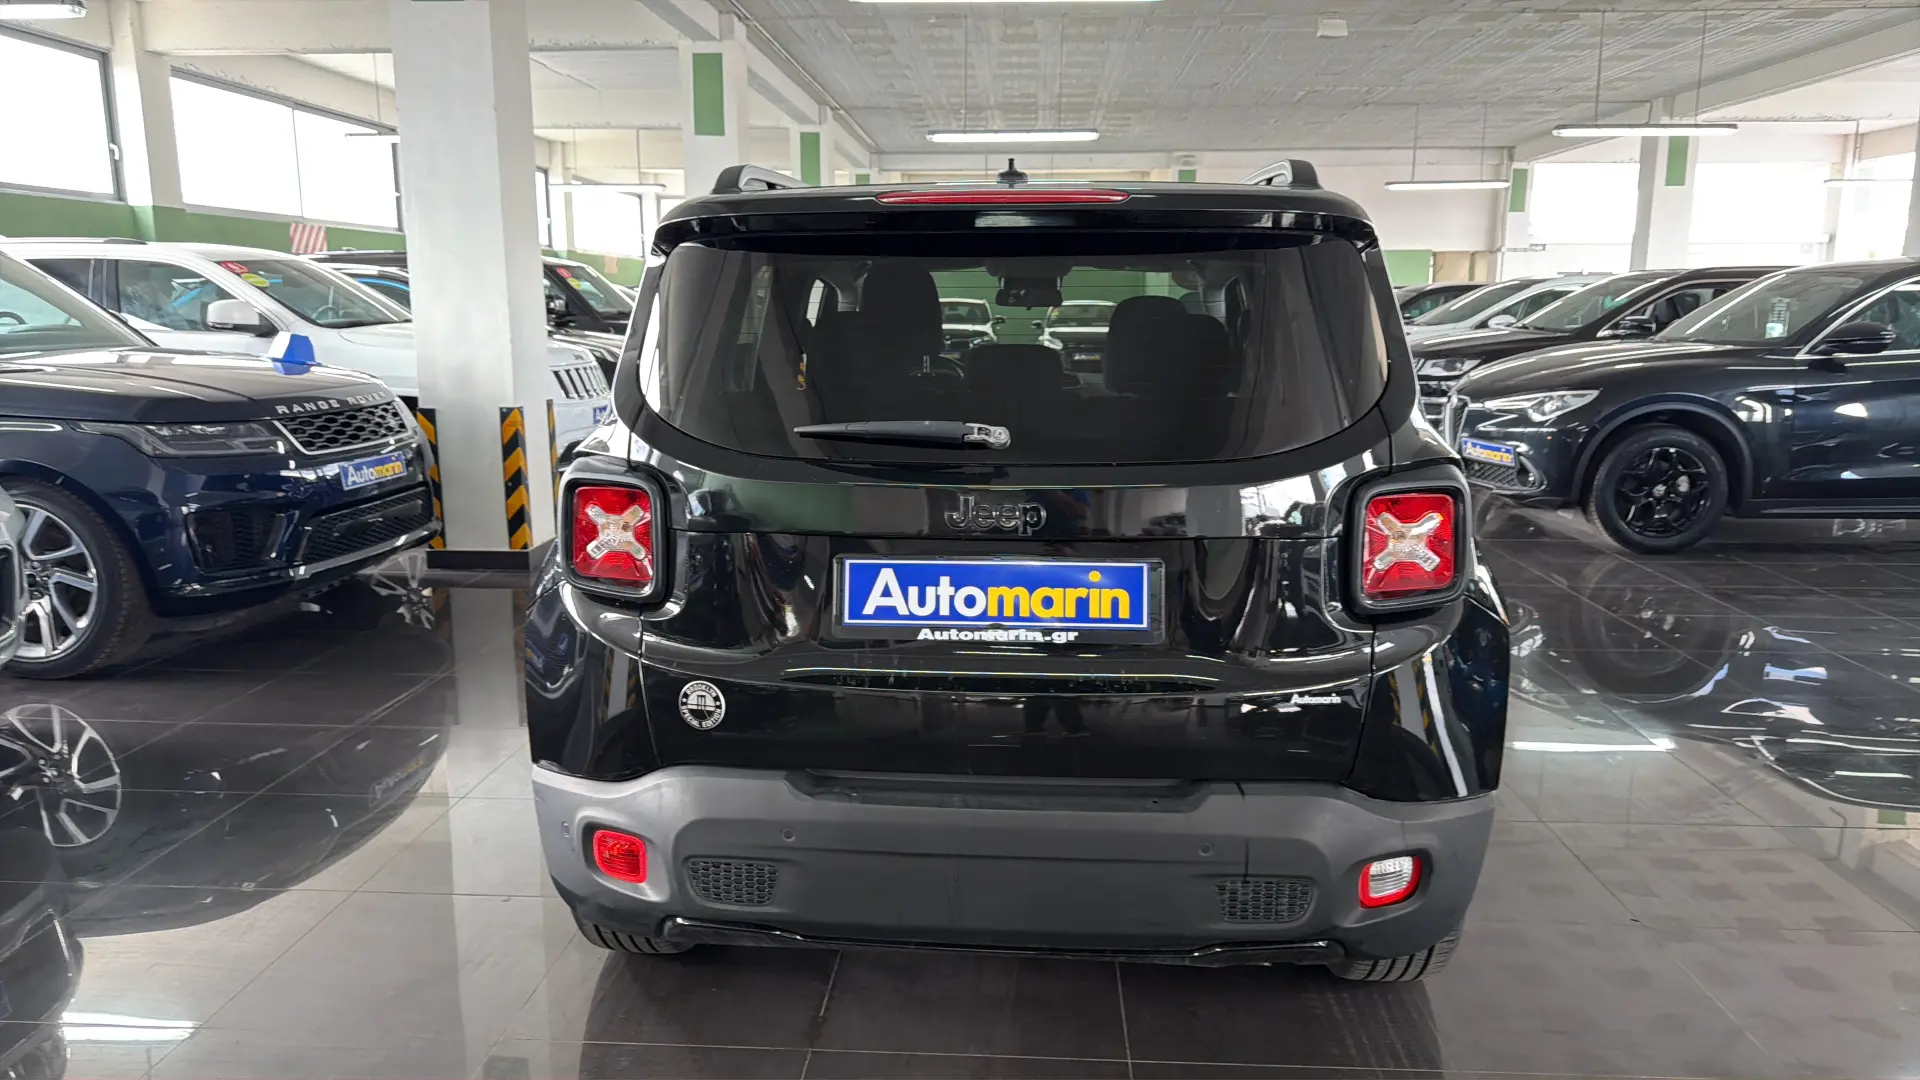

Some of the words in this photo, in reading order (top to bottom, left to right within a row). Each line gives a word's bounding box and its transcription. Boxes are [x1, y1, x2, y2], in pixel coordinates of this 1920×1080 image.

[274, 399, 341, 415] RANGE
[346, 391, 386, 406] ROVER
[346, 456, 404, 486] Automarin
[944, 495, 1047, 537] Jeep
[861, 567, 1131, 619] Automarin
[916, 628, 1079, 644] Automarin.gr
[1290, 693, 1342, 704] Automarin
[701, 708, 722, 728] EDITION
